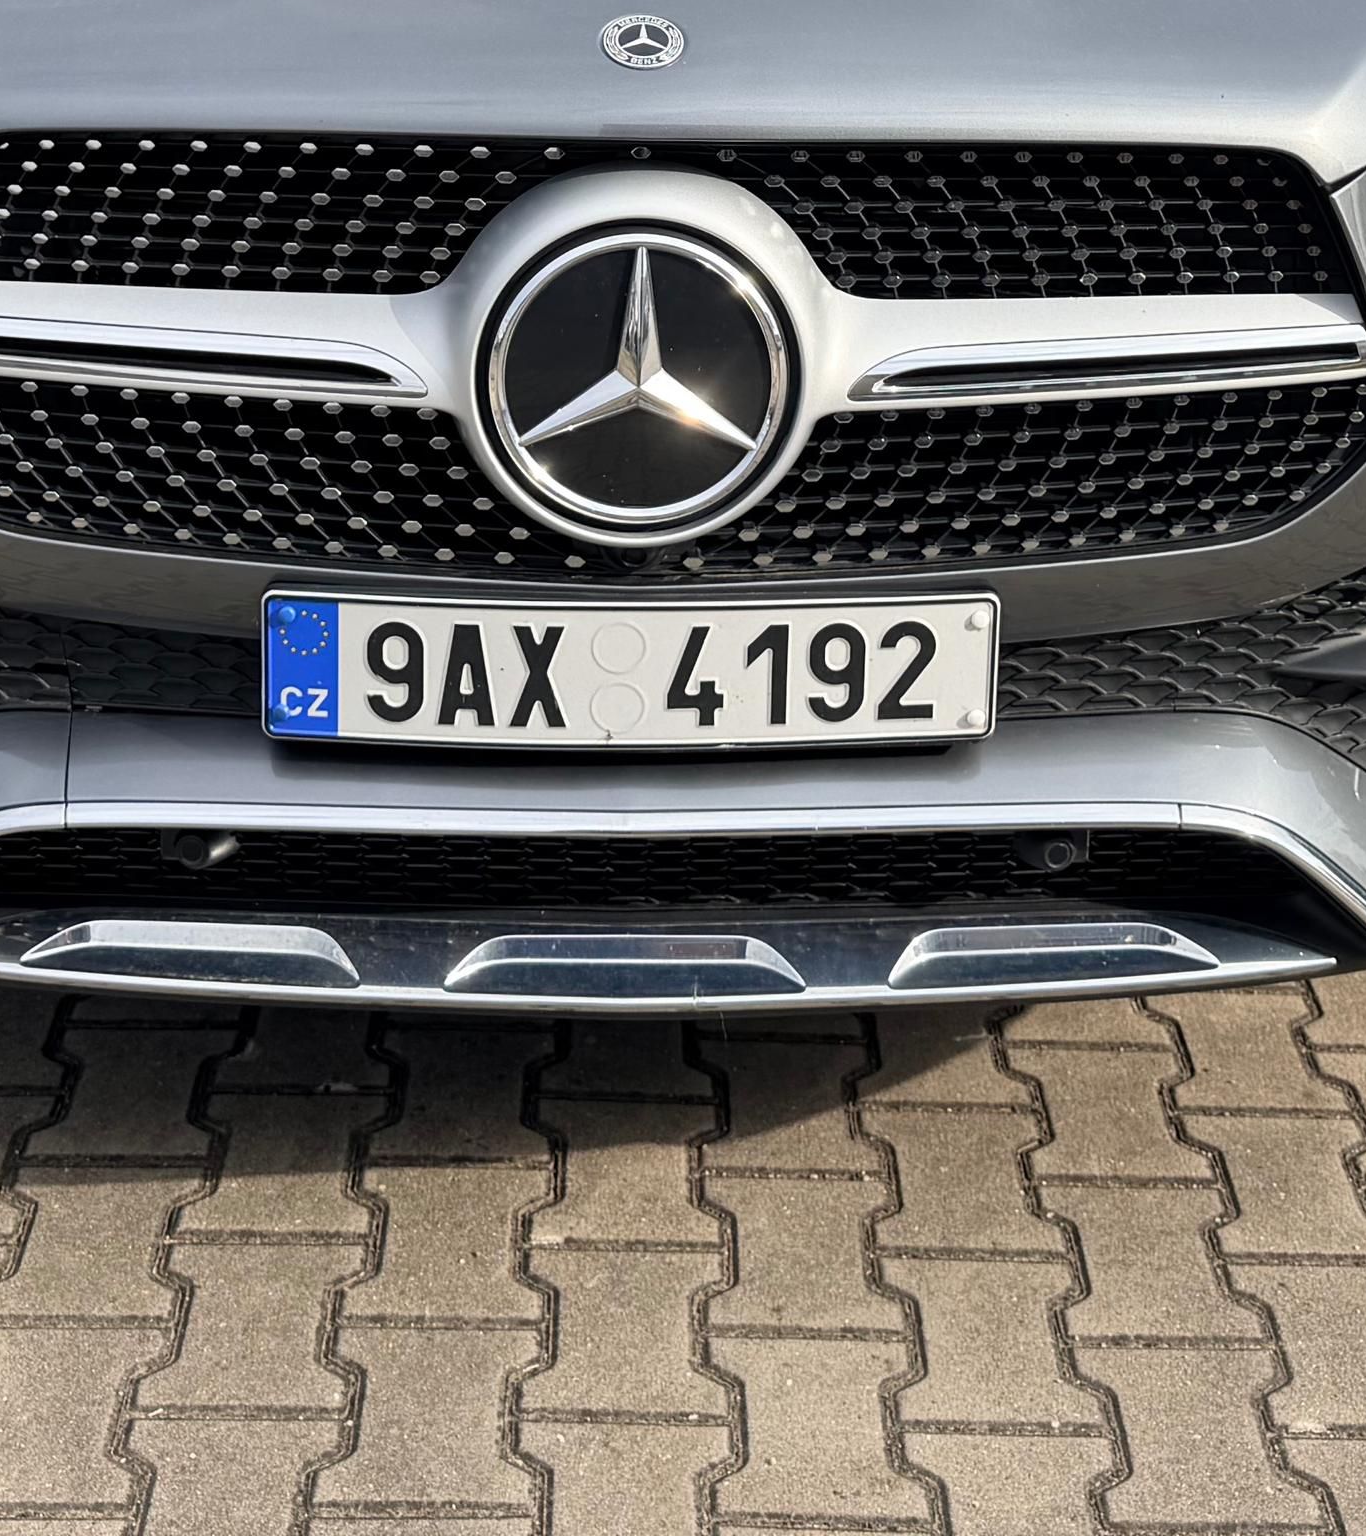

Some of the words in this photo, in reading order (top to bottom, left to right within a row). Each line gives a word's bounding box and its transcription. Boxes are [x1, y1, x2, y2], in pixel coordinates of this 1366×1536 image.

[280, 686, 329, 718] CZ
[366, 621, 567, 728] 9AX
[666, 620, 936, 727] 4192
